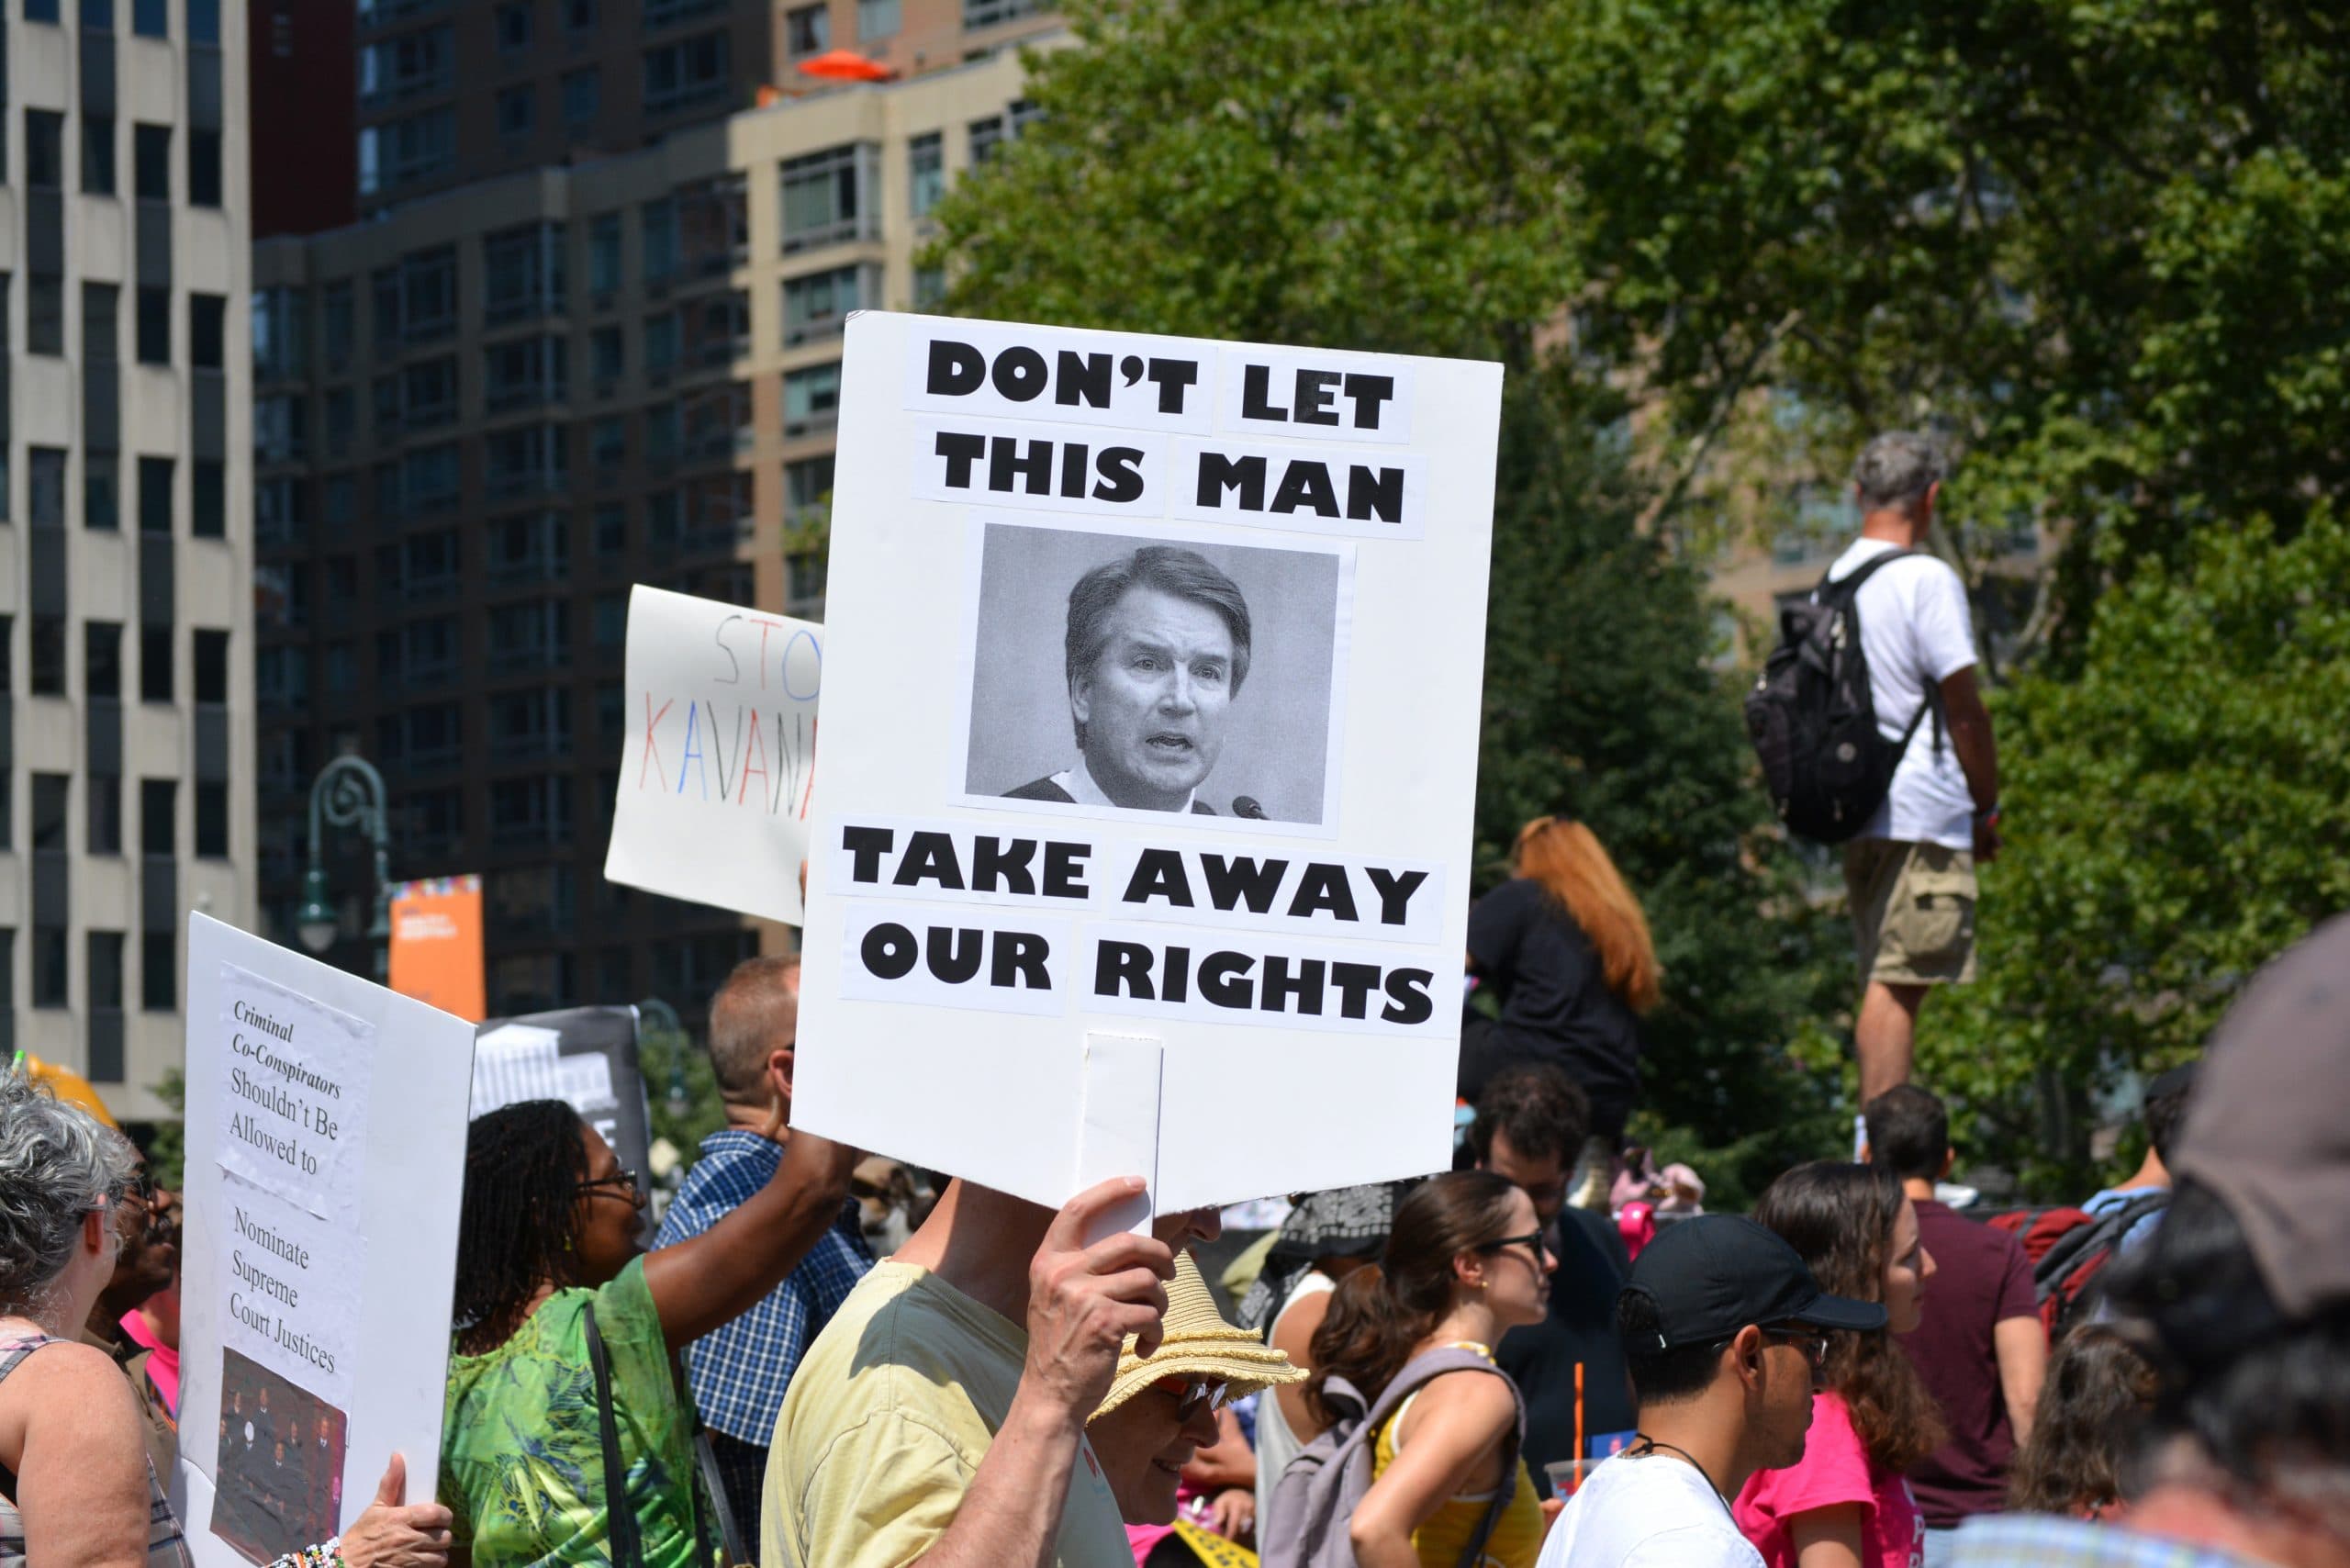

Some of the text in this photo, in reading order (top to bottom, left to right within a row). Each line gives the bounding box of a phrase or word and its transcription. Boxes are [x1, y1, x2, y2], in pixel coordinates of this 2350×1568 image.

[927, 341, 1393, 429] DON'T LET
[935, 432, 1404, 523] THIS MAN
[845, 826, 1428, 925] TAKE AWAY
[861, 924, 1433, 1024] OUR RIGHTS
[234, 1000, 294, 1043] Criminal
[232, 1033, 341, 1100] Co-Conspirators
[231, 1067, 339, 1140] Shouldn't Be
[229, 1111, 317, 1175] Allowed to
[234, 1205, 309, 1270] Nominate
[232, 1249, 298, 1308] Supreme
[230, 1293, 335, 1373] Court Justices
